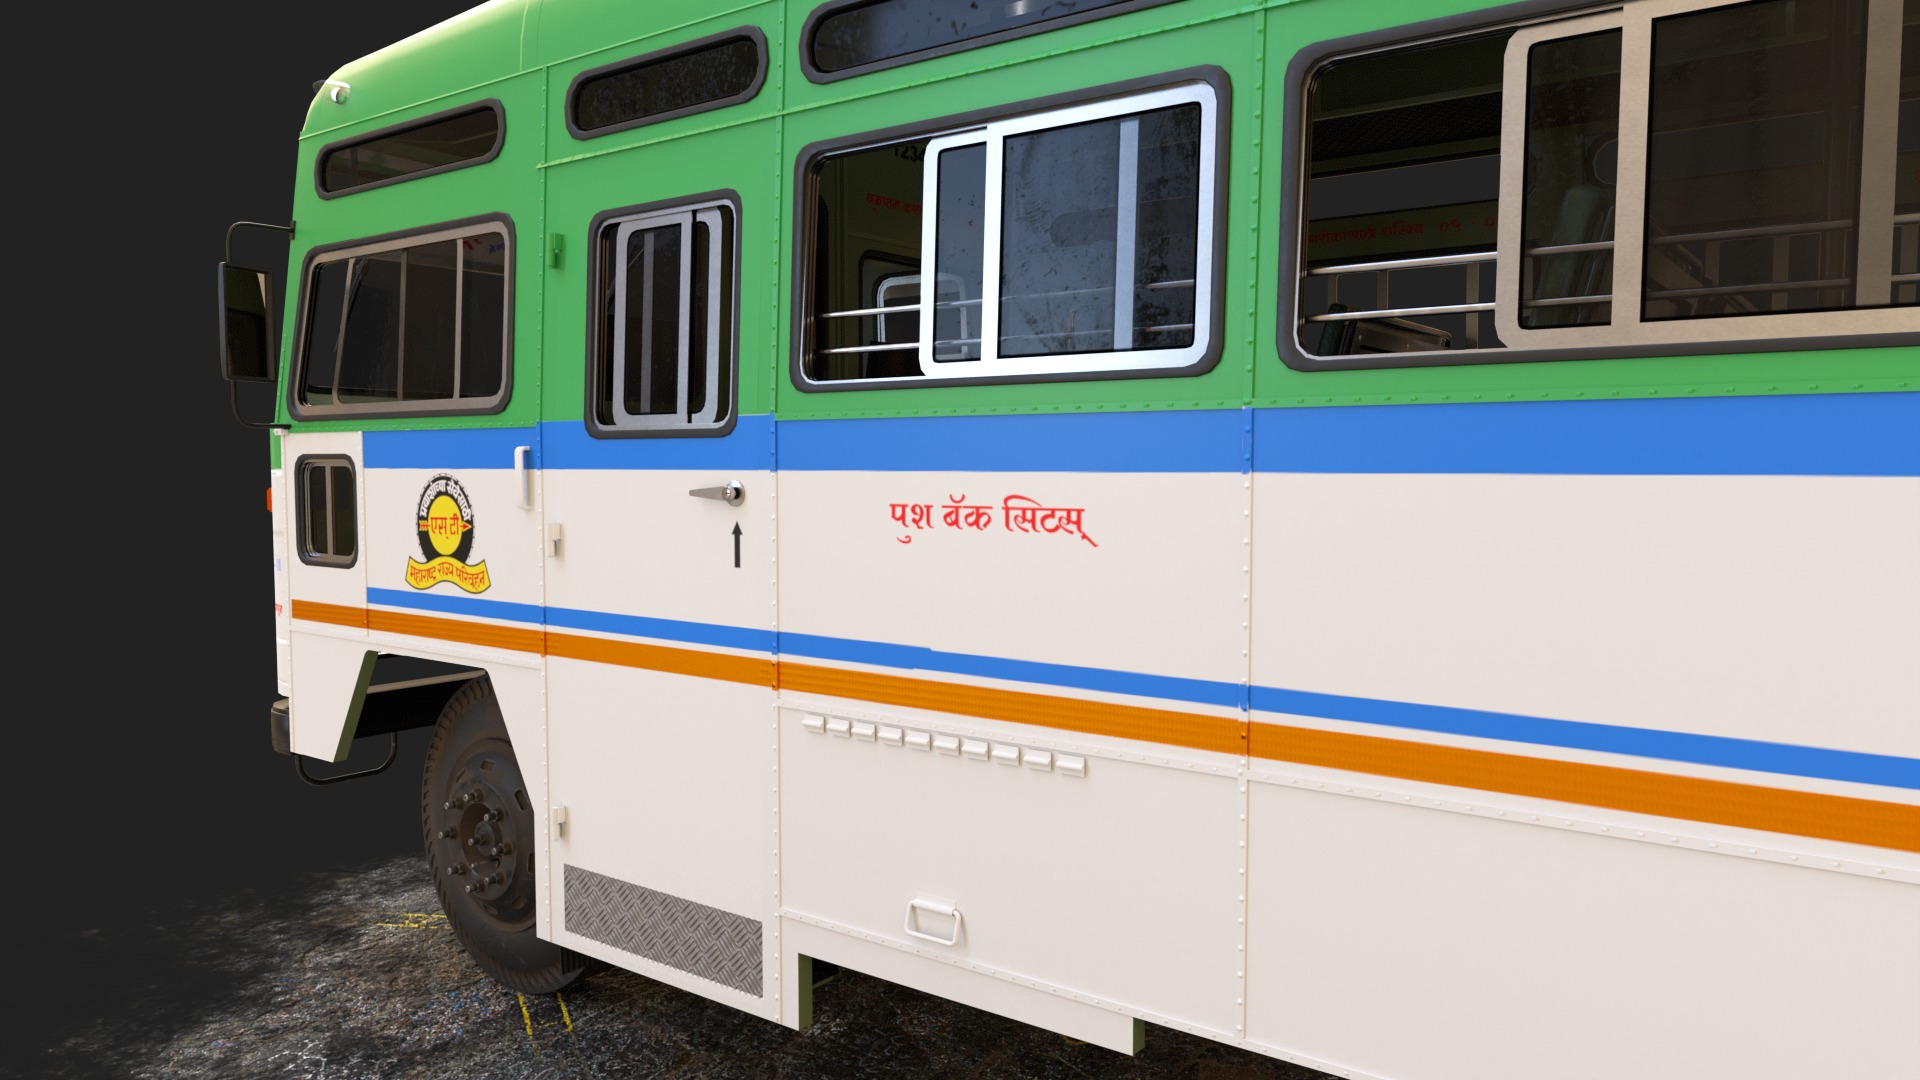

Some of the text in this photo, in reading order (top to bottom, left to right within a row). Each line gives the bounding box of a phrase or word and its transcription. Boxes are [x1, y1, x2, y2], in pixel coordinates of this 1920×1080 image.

[889, 493, 1099, 548] पुश बॅक सिटस्
